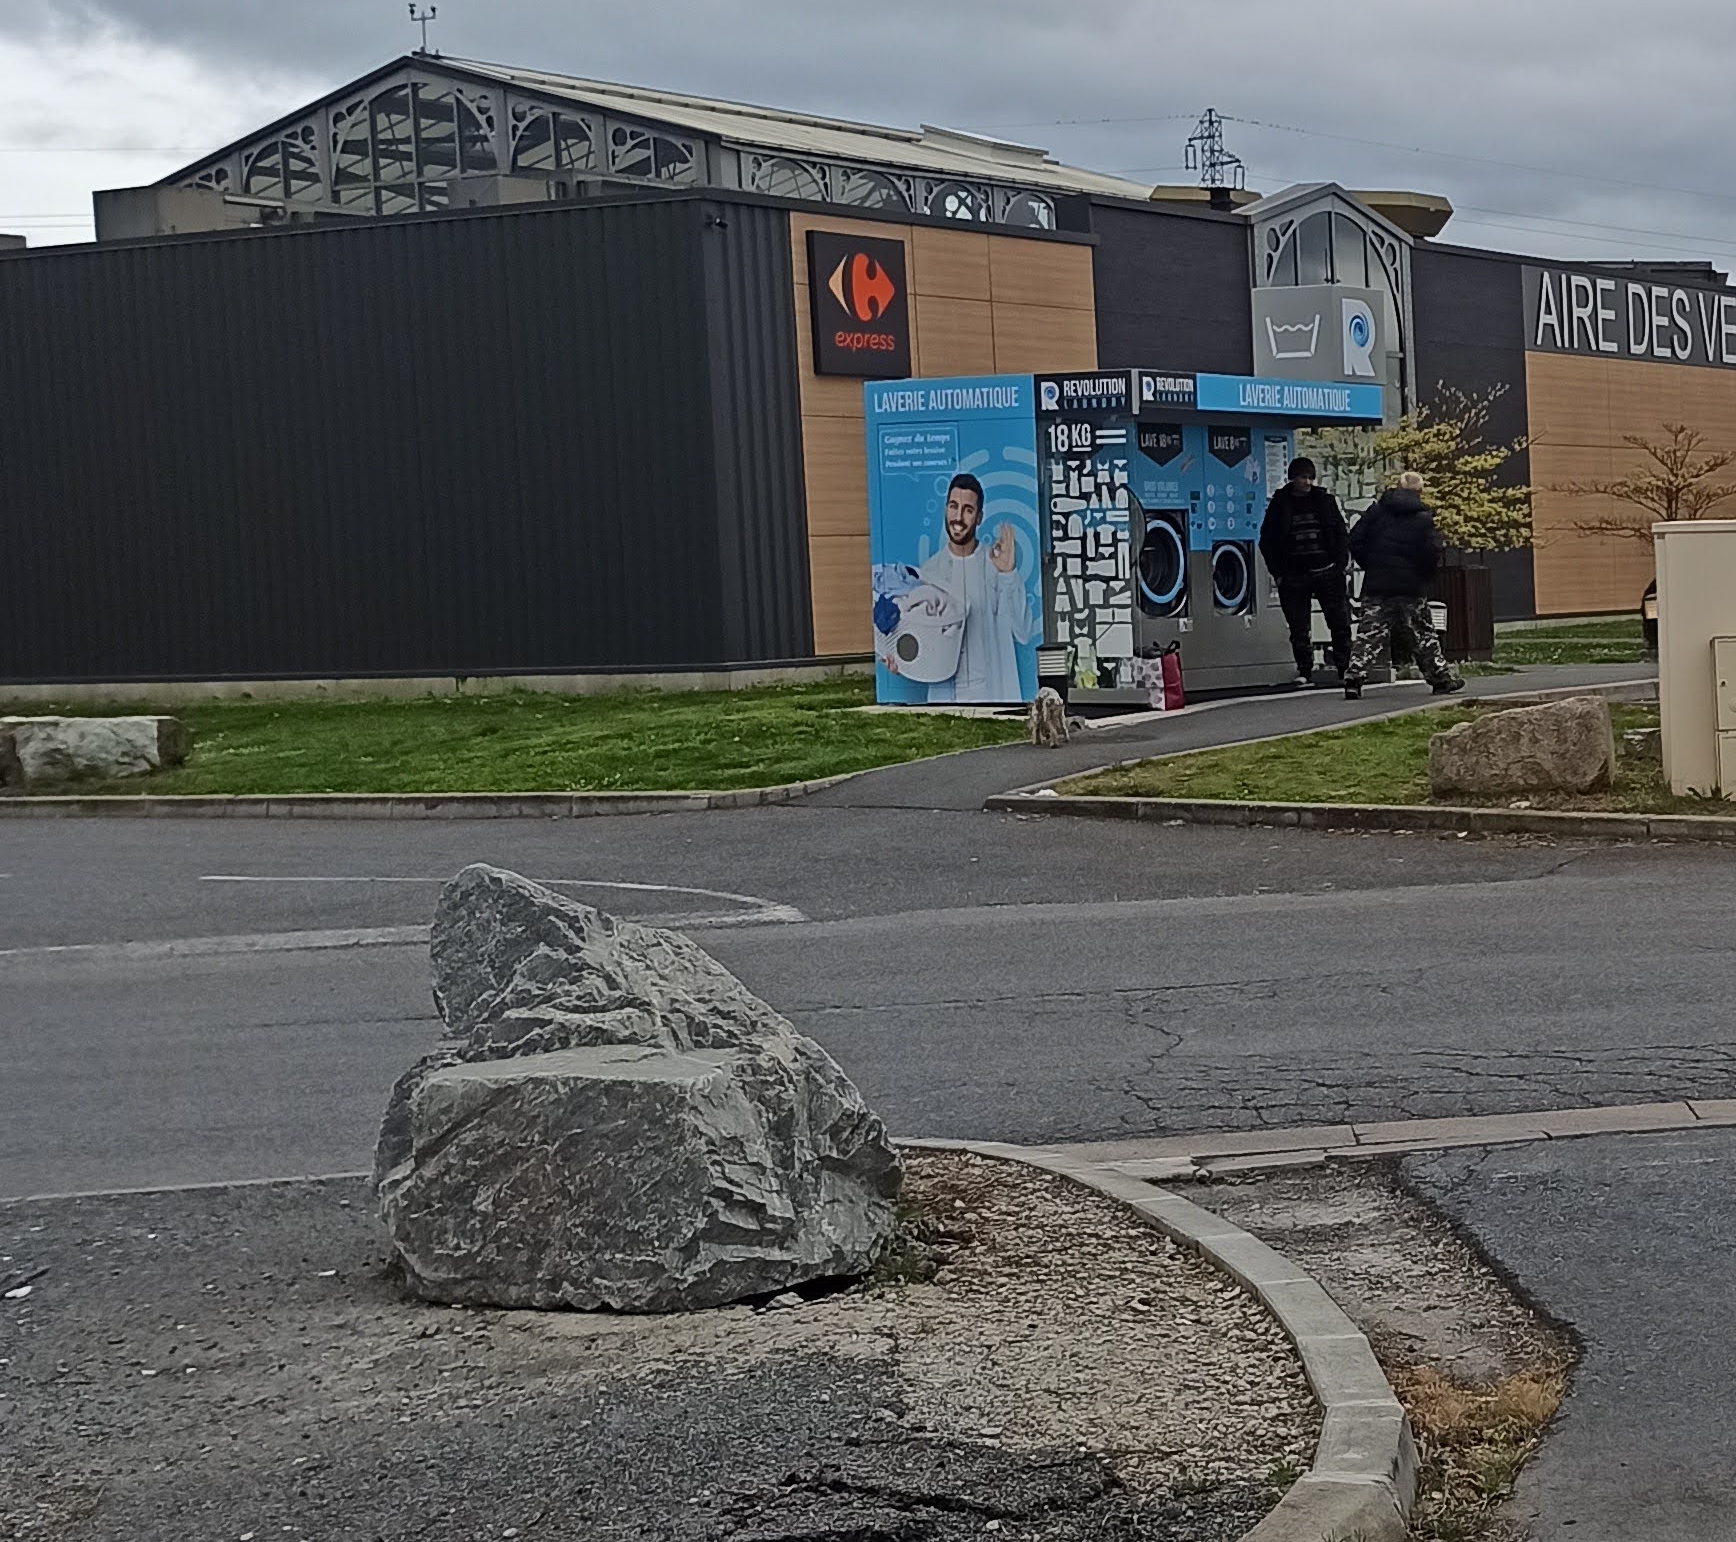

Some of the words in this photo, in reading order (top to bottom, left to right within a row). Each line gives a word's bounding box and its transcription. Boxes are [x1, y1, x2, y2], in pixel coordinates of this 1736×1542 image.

[1536, 271, 1618, 352] AIRE
[1627, 282, 1692, 360] DES
[835, 331, 895, 351] express
[1064, 378, 1126, 397] REVOLUTION
[1156, 377, 1194, 392] REVOLUTION
[1239, 384, 1281, 407] LAVERIE
[1283, 387, 1351, 411] AUTOMATIQUE
[874, 391, 926, 413] LAVERIE
[928, 386, 1020, 410] AUTOMATIQUE
[1048, 424, 1069, 453] 18
[1072, 423, 1092, 446] KG
